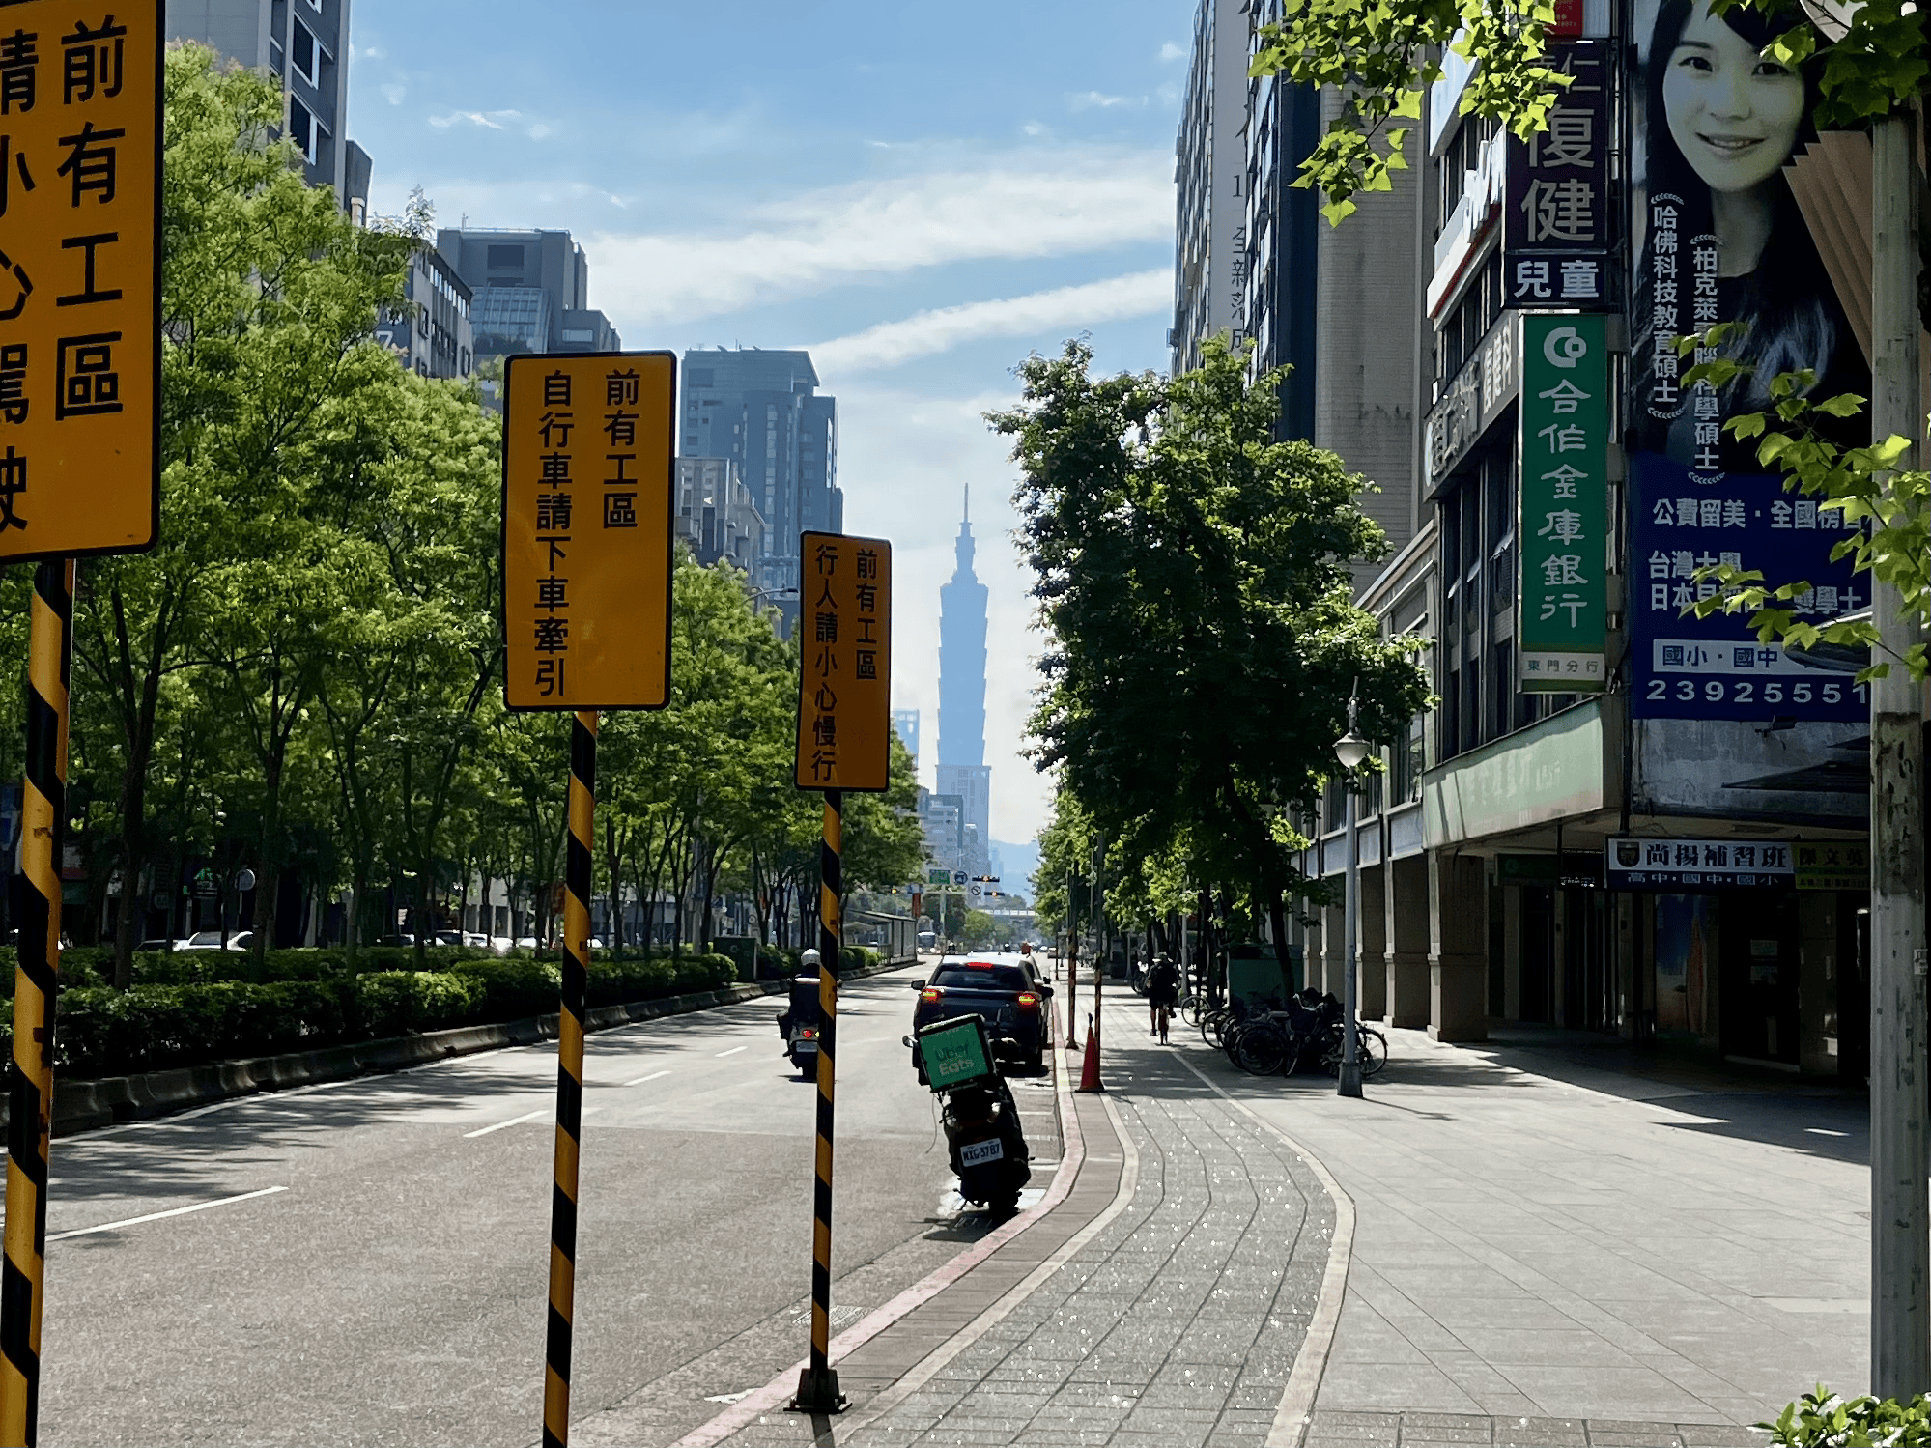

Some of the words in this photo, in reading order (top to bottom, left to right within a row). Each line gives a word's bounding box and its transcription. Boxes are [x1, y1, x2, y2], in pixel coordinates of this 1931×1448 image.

[56, 14, 127, 421] 前有工區
[1520, 104, 1596, 242] 復健
[1514, 260, 1599, 298] 兒童
[1653, 205, 1678, 402] 哈佛科技教育碩士
[603, 368, 640, 529] 前有工區
[1538, 379, 1591, 628] 合作金庫銀行
[534, 370, 574, 697] 自行車請下車牽引
[811, 543, 838, 782] 行人請小心慢行
[856, 548, 877, 680] 前有工區
[1527, 659, 1599, 673] 東門分行
[1646, 679, 1866, 704] 23925551
[1646, 843, 1787, 868] 尚揚補習班
[939, 1059, 975, 1076] Eats
